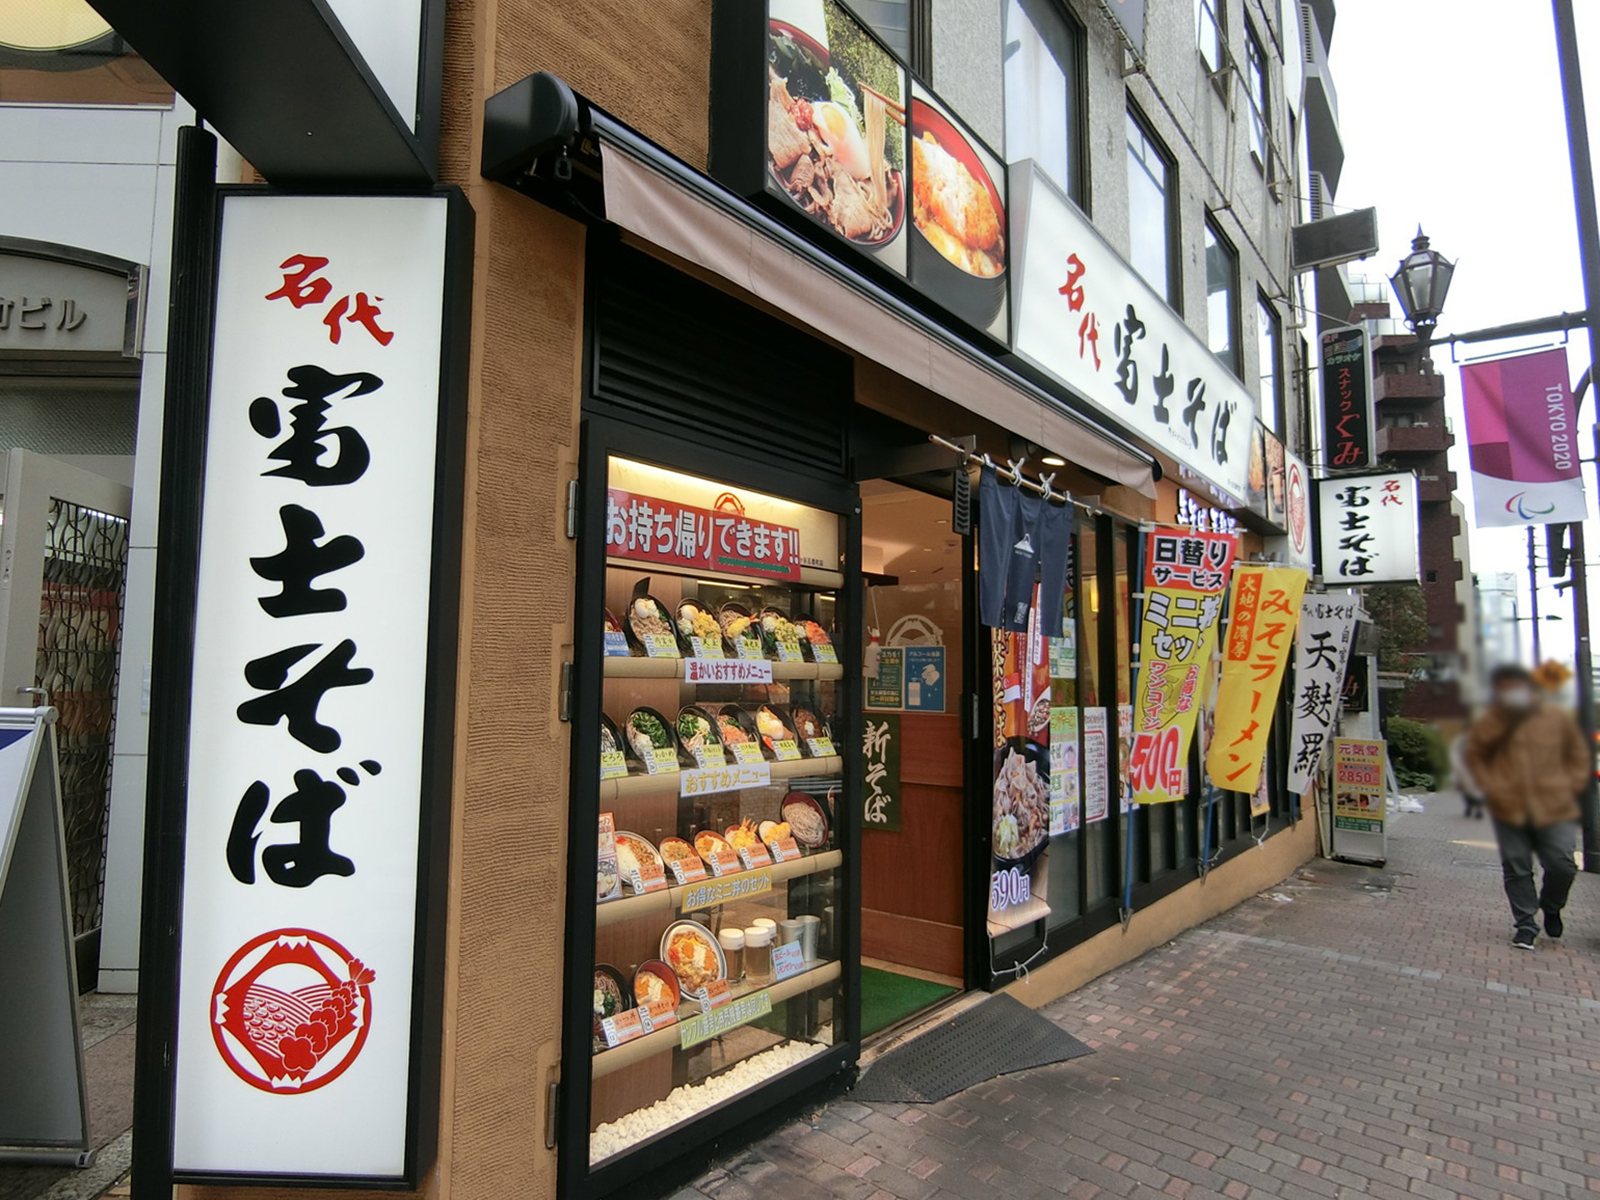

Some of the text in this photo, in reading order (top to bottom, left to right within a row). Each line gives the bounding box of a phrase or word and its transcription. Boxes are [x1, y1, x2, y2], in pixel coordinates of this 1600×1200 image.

[265, 253, 395, 347] 名代
[1058, 253, 1101, 372] 名代
[1113, 303, 1239, 467] 富士そば
[1338, 367, 1352, 411] スナック
[1545, 383, 1572, 471] TOKYO 2020
[1380, 479, 1403, 507] 名代
[1153, 535, 1230, 569] 日替り
[1335, 485, 1380, 577] 富士そば
[1152, 565, 1225, 590] サービス
[226, 364, 384, 888] 富士そば
[690, 661, 771, 681] 温かいおすすめメニュー
[1141, 660, 1168, 731] ワンコイン
[1225, 589, 1294, 782] みそラーメン
[686, 769, 769, 793] おすすめメニュー
[862, 719, 892, 823] 新そば
[1130, 725, 1182, 797] 500円
[991, 867, 1030, 911] 590円
